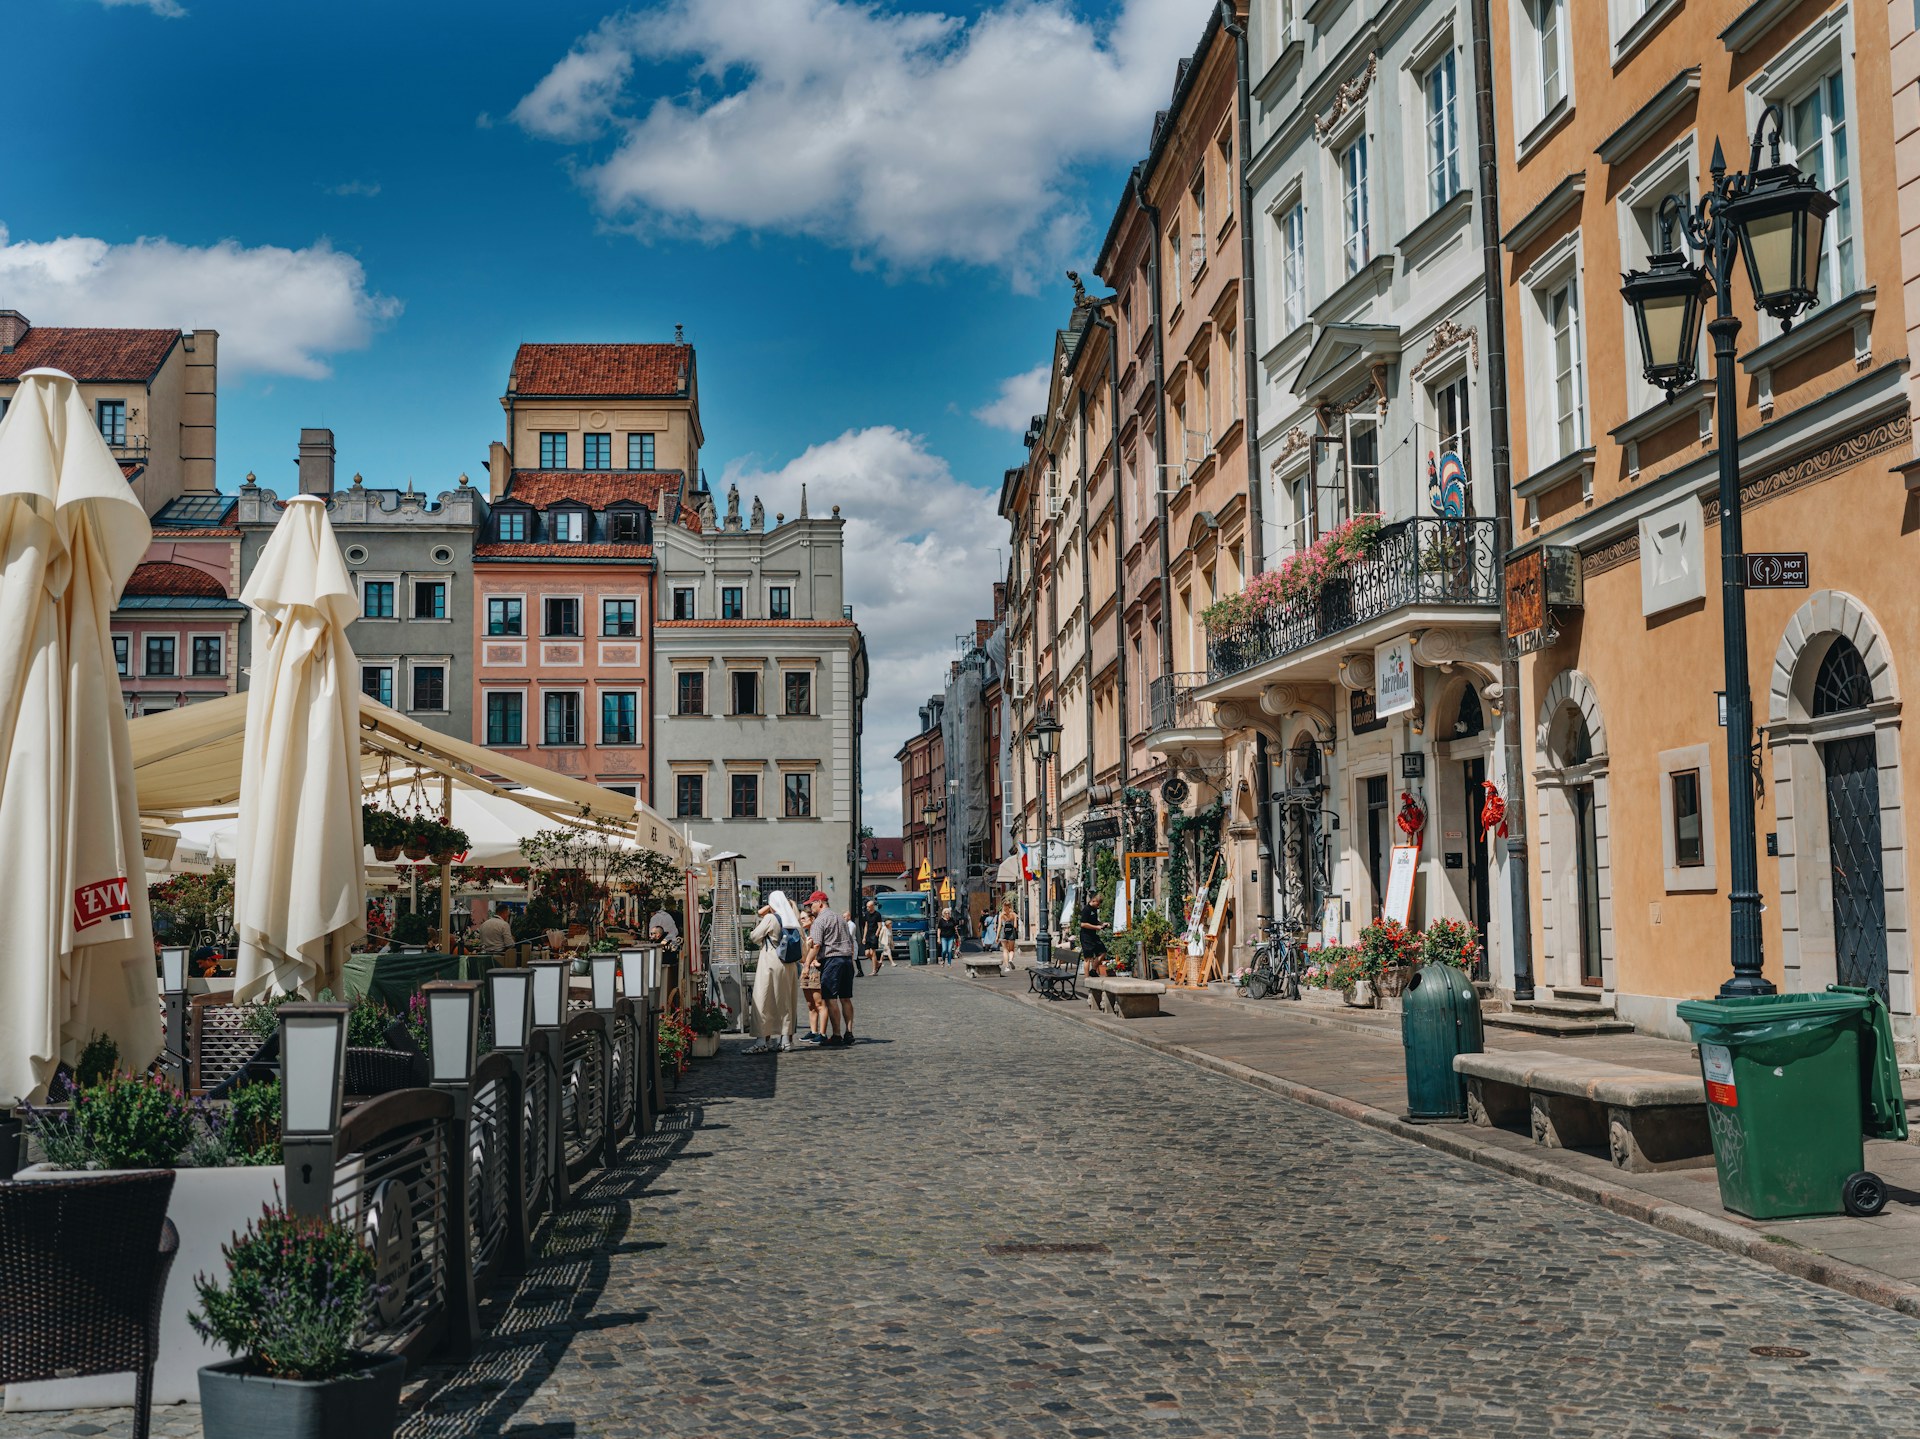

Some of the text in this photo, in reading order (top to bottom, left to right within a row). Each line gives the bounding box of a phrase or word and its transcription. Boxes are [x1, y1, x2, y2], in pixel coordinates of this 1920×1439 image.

[1783, 560, 1801, 569] HOT
[1782, 571, 1804, 580] SPOT
[1406, 757, 1417, 766] 10
